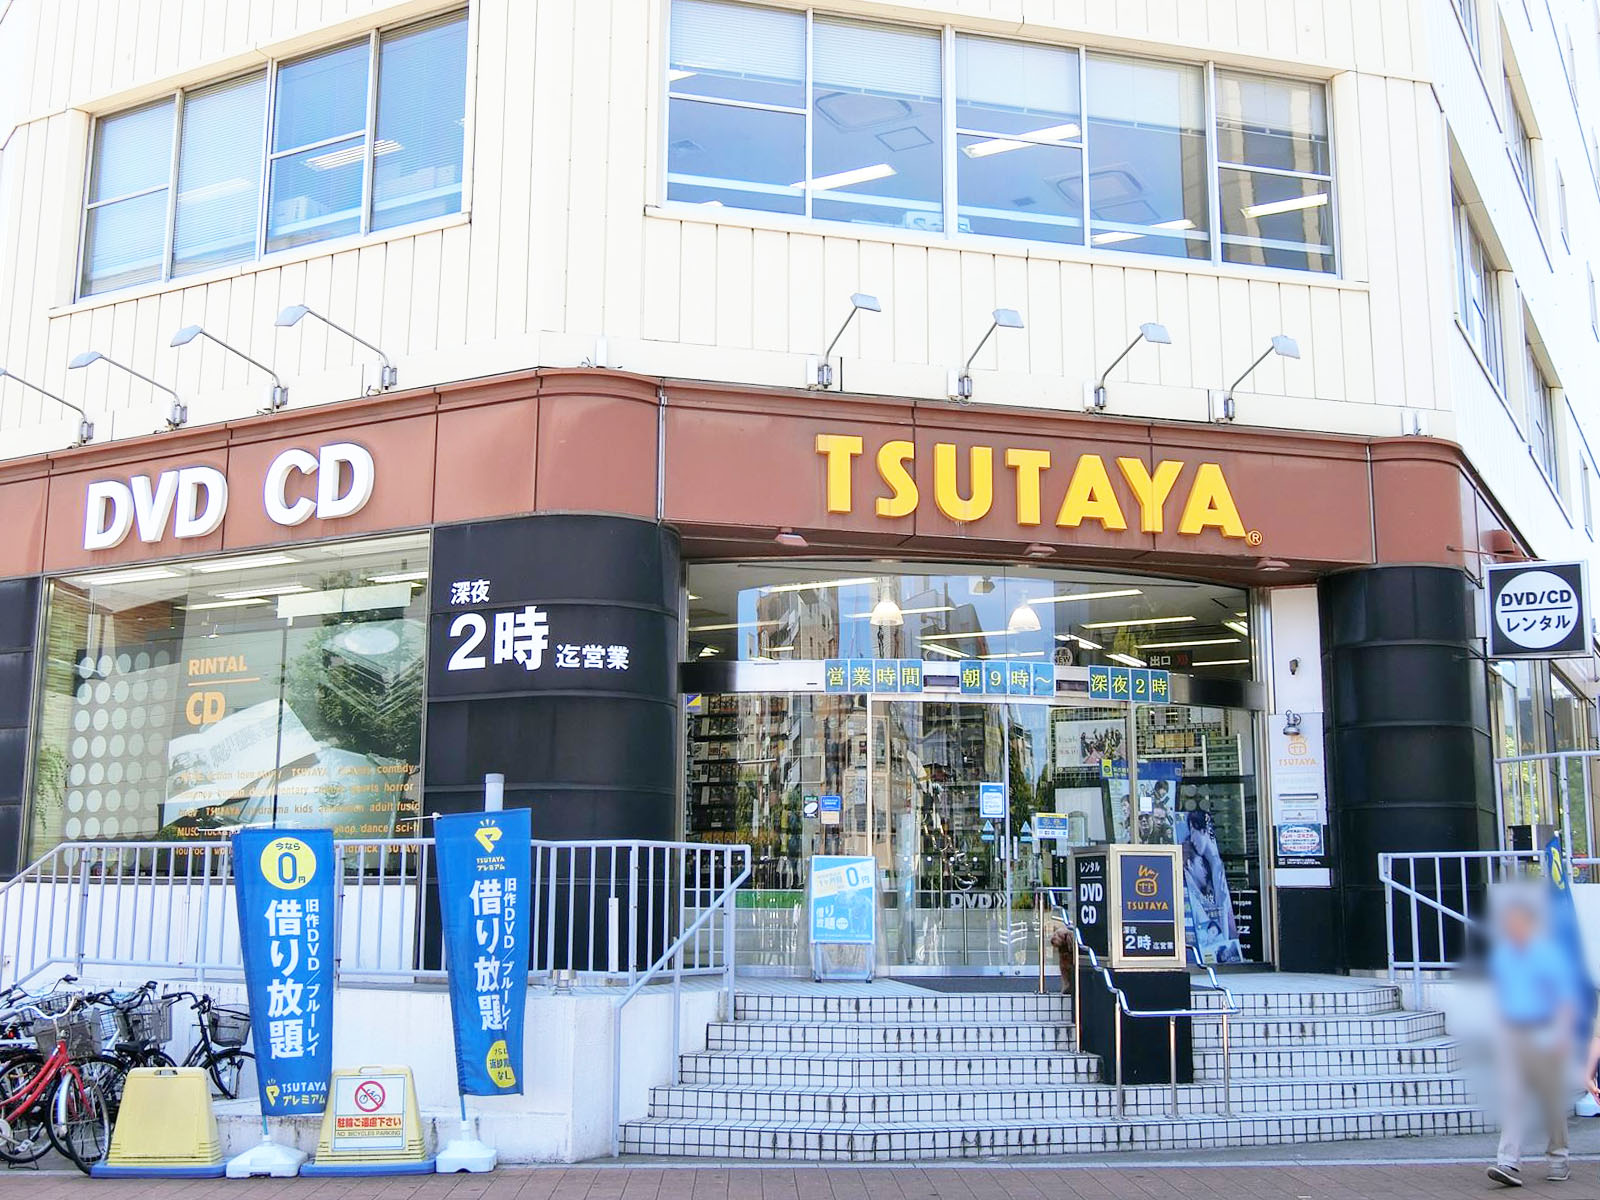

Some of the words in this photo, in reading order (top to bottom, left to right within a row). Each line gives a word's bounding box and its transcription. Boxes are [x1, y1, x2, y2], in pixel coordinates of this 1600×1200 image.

[815, 433, 1247, 539] TSUTAYA
[83, 466, 229, 551] DVD
[264, 442, 375, 526] CD
[450, 579, 491, 605] 深夜
[1501, 589, 1572, 607] DVD/CD
[1507, 615, 1571, 632] レンタル
[448, 606, 549, 671] 2時
[556, 643, 629, 670] 迄営業
[188, 655, 248, 677] RINTAL
[1149, 655, 1171, 667] 出口
[827, 666, 920, 687] 営業時間
[1091, 674, 1168, 696] 深夜2時
[186, 691, 226, 726] CD
[376, 763, 415, 776] comedy
[384, 783, 414, 793] horror
[294, 803, 314, 814] kids
[360, 822, 389, 833] dance
[275, 842, 301, 851] 今なら
[476, 856, 505, 864] TSUTAYA
[1080, 862, 1101, 873] レンタル
[950, 892, 992, 909] DVD
[1080, 883, 1103, 902] DVD
[1081, 905, 1097, 924] CD
[1127, 901, 1169, 911] TSUTAYA
[1125, 934, 1152, 951] 2時
[469, 879, 503, 1032] 借り放題
[264, 899, 303, 1060] 借り放題
[282, 1081, 327, 1093] TSUTAYA
[283, 1094, 326, 1107] プレミアム
